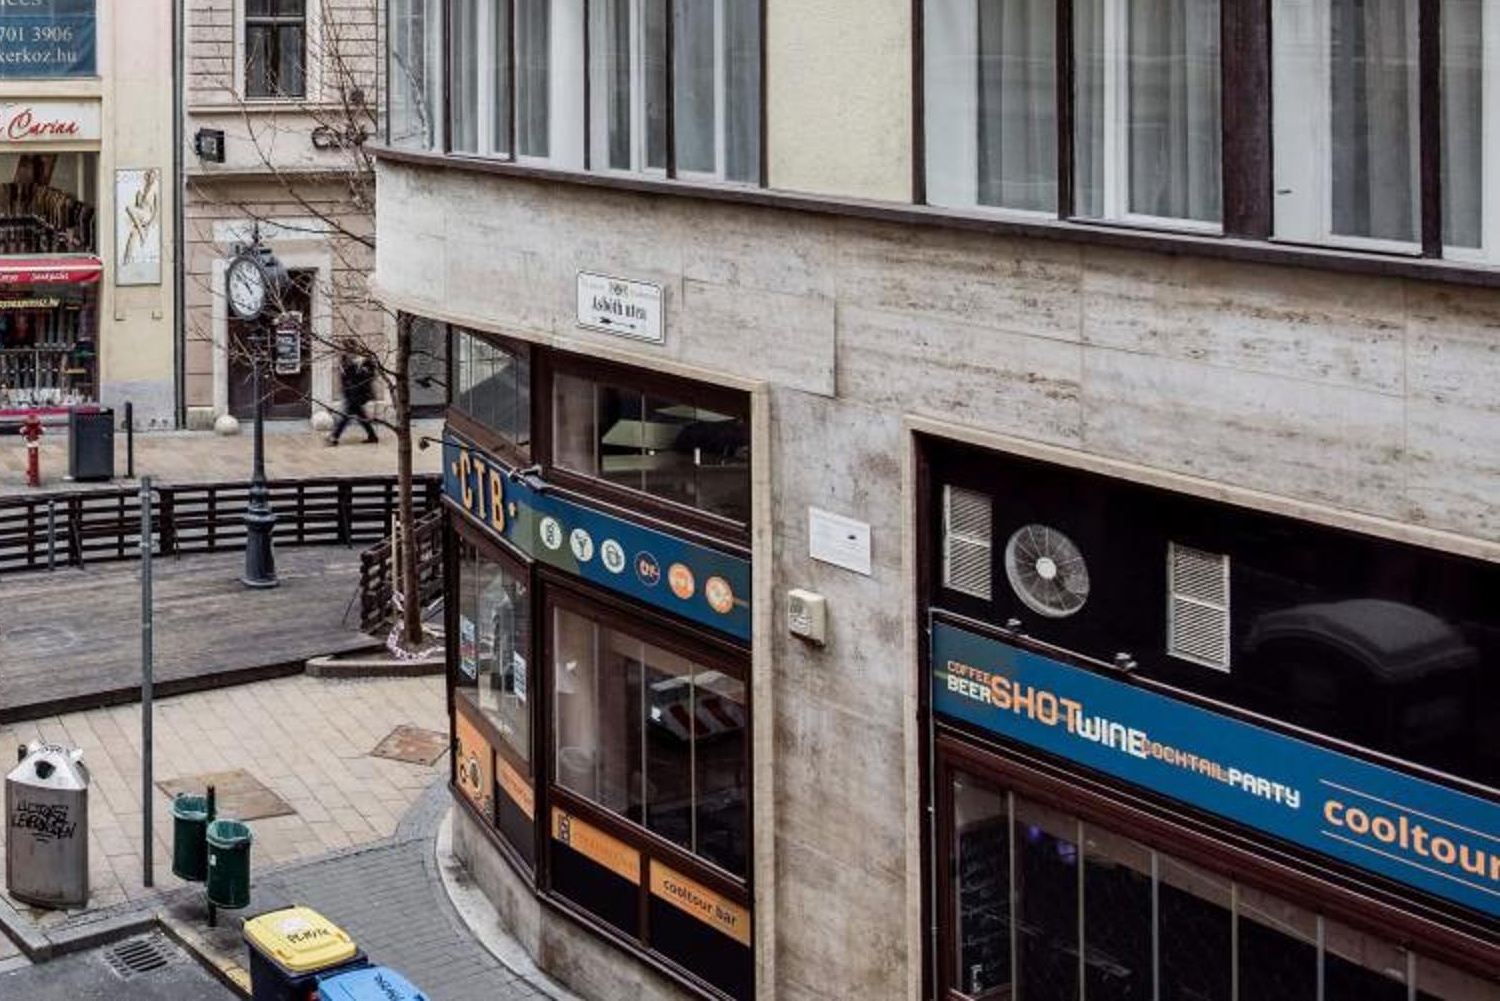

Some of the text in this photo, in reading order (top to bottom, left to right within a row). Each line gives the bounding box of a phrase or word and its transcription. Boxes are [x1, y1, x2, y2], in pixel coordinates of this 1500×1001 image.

[32, 26, 73, 42] 3906
[947, 674, 992, 704] BEER
[991, 676, 1082, 734] SHOT
[1076, 709, 1148, 760] WINE
[1227, 767, 1301, 810] PARTY
[663, 879, 738, 928] cooltour bar
